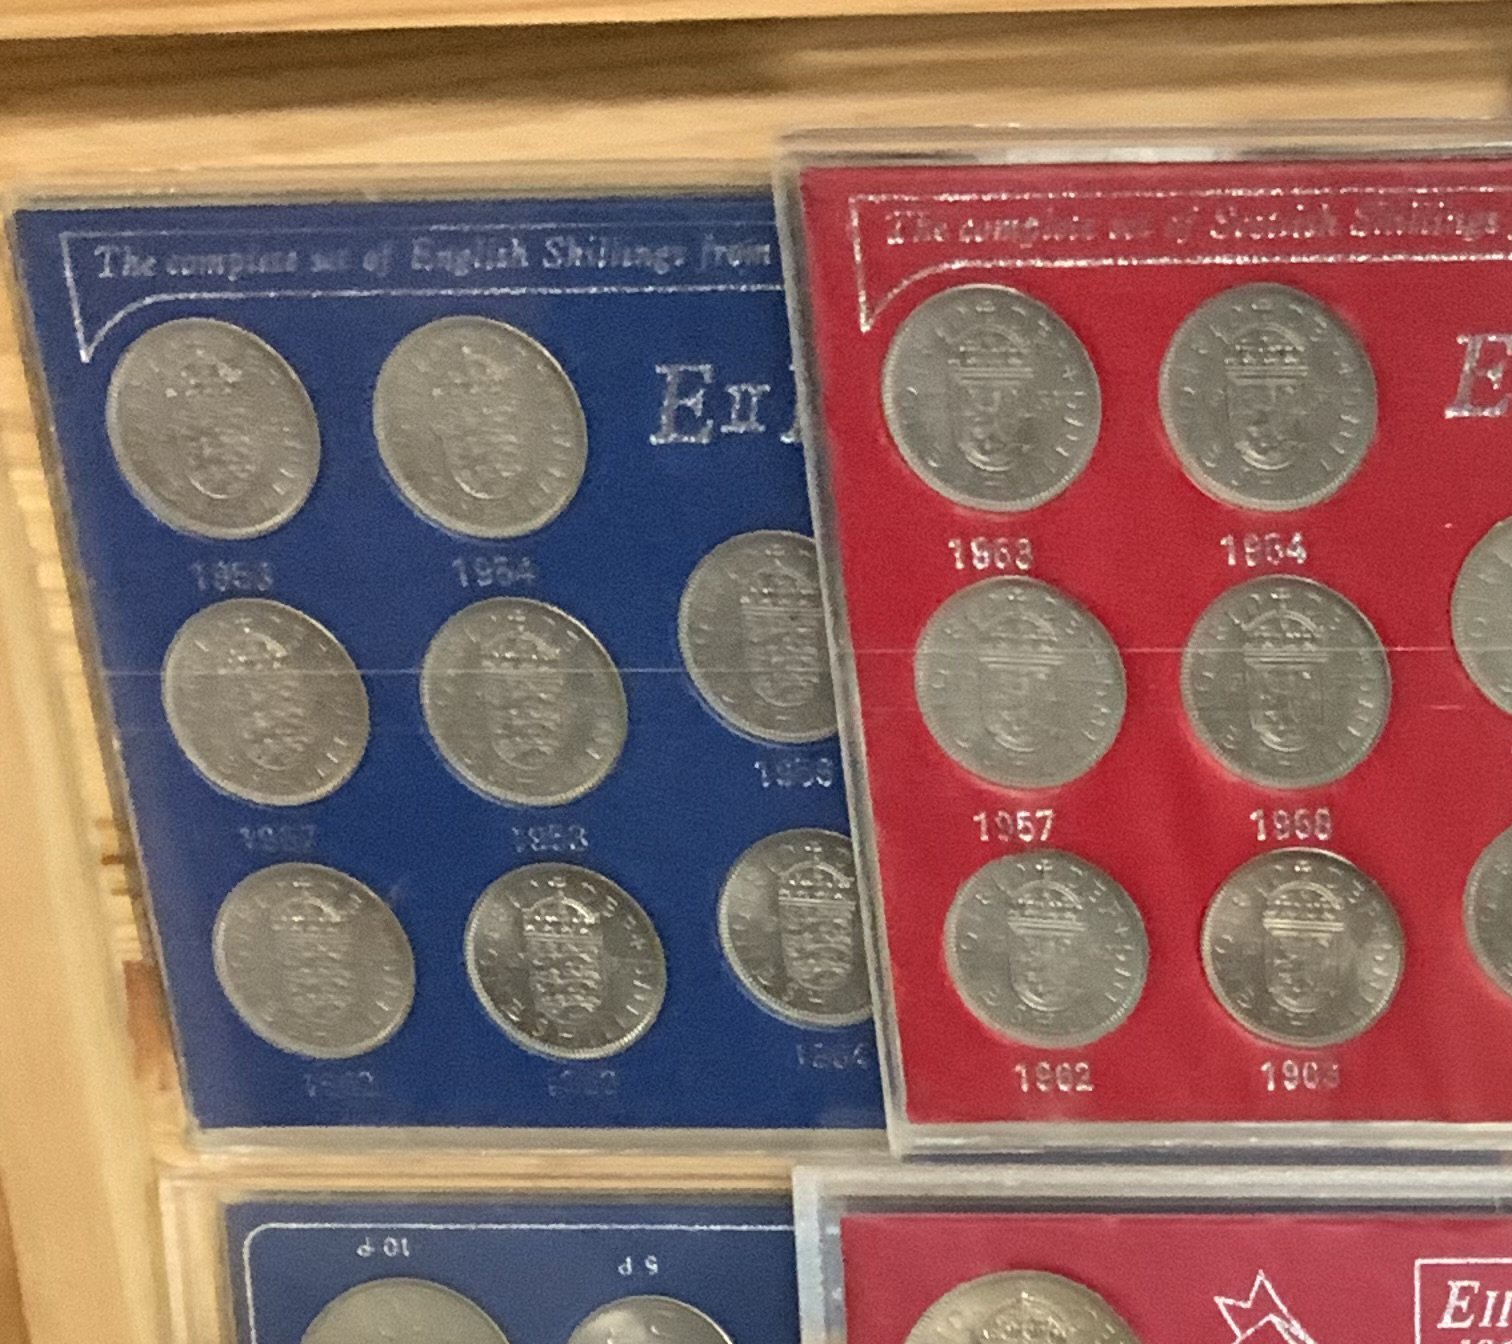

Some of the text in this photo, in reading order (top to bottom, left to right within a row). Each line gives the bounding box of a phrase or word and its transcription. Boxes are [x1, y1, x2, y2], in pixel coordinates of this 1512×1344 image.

[357, 1236, 411, 1257] 10 P
[618, 1255, 659, 1276] 5 P
